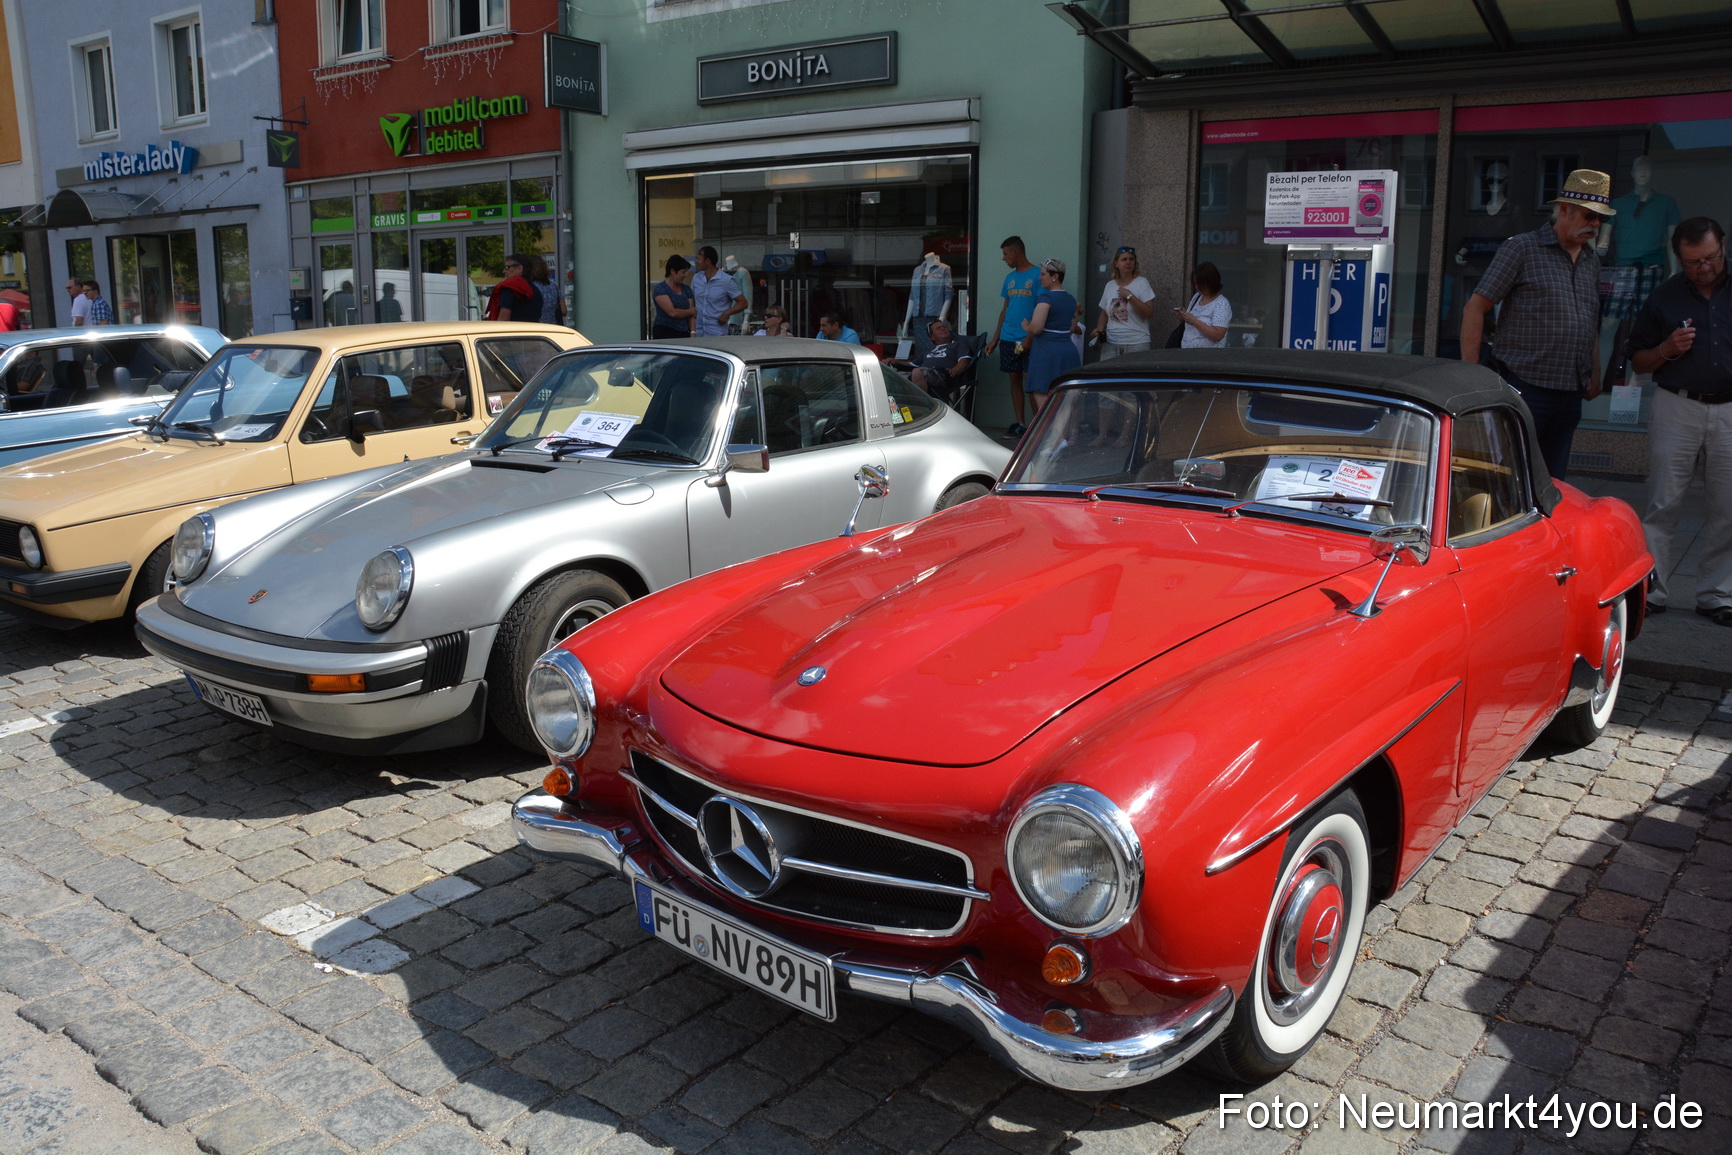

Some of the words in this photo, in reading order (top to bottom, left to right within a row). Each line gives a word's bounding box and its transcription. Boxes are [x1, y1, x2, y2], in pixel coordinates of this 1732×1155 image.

[424, 94, 524, 126] mobilcom
[426, 126, 482, 154] debitel
[1206, 131, 1259, 140] www.adlermode.com
[1269, 175, 1300, 184] Bezahl
[1301, 176, 1316, 185] per
[1318, 174, 1352, 183] Telefon
[374, 213, 406, 227] GRAVIS
[1307, 212, 1345, 223] 923001
[1303, 263, 1356, 280] HER
[1378, 283, 1388, 316] P
[597, 421, 621, 432] 364
[1319, 468, 1334, 482] 2
[644, 912, 650, 924] D
[654, 897, 691, 948] FÜ
